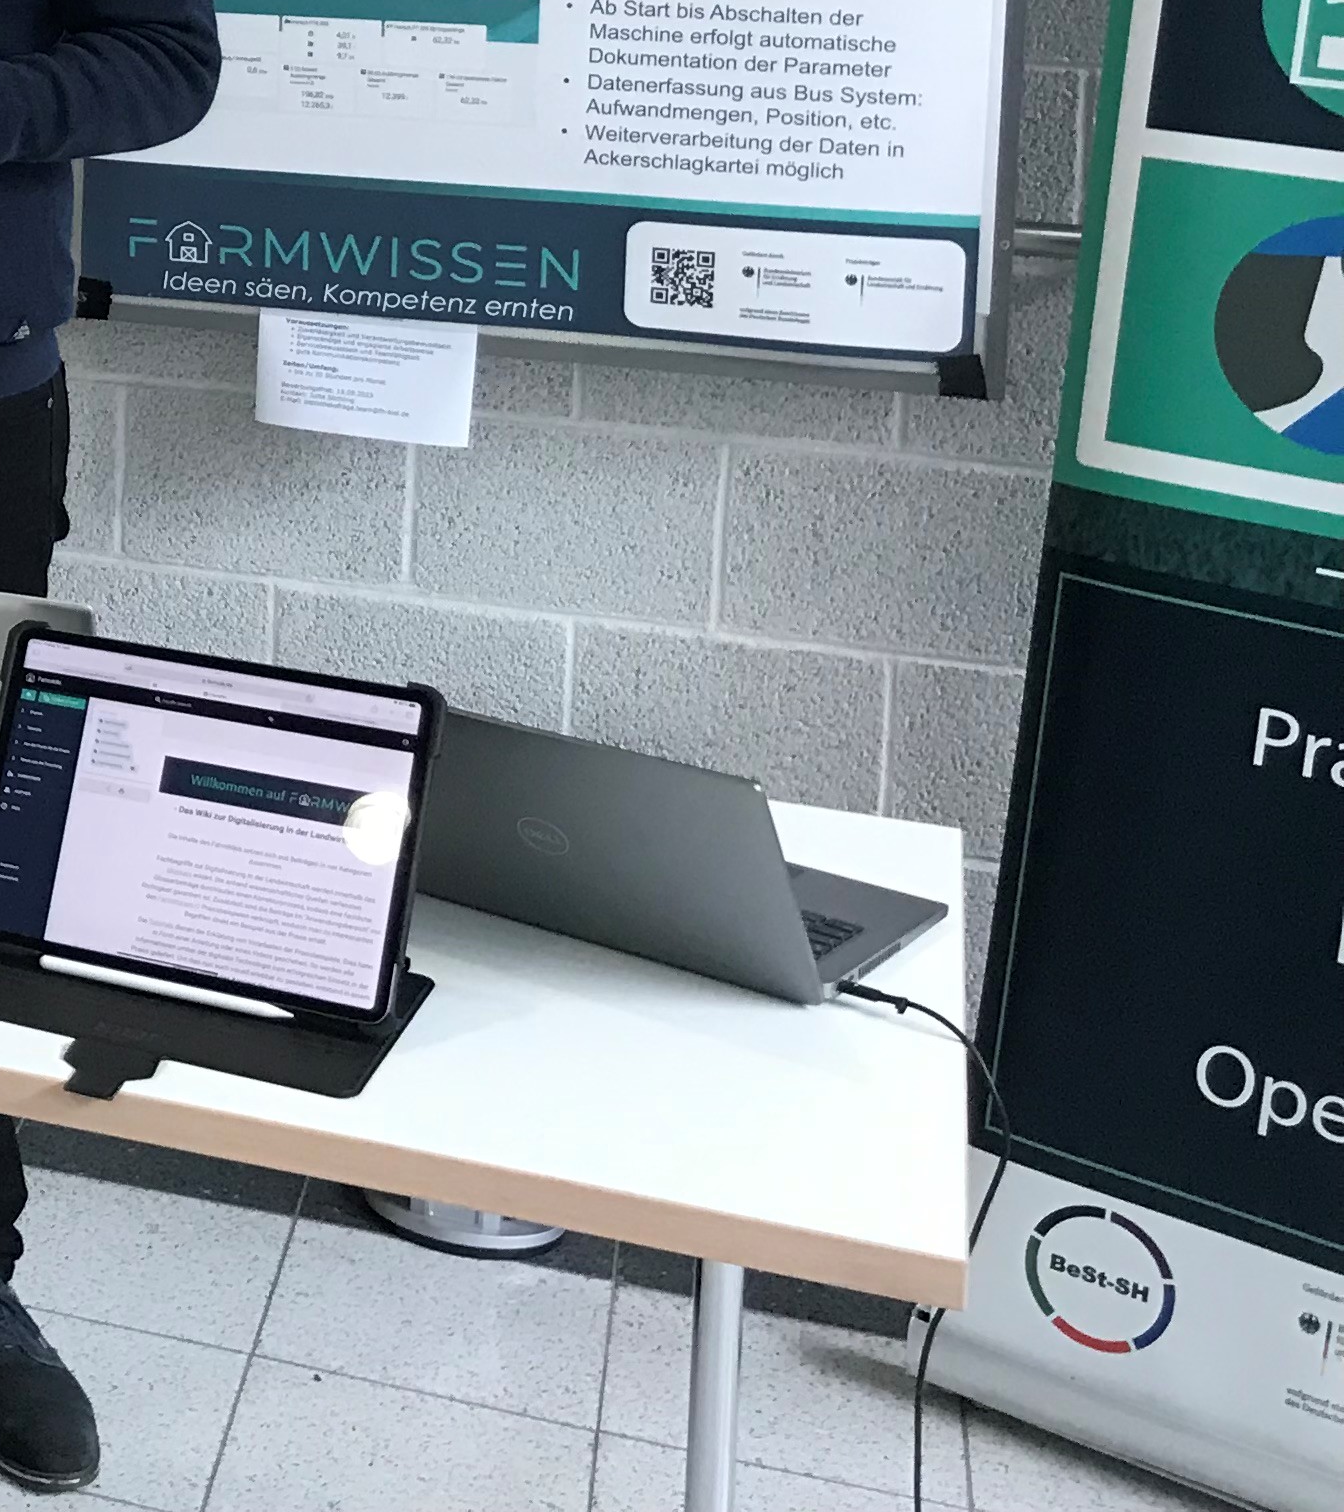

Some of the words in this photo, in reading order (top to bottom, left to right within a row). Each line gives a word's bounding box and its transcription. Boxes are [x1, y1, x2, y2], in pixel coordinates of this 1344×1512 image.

[623, 0, 671, 18] Start
[676, 2, 705, 20] bis
[709, 3, 822, 25] Abschalten
[828, 9, 864, 27] der
[589, 22, 684, 44] Maschine
[690, 28, 753, 51] erfolgt
[759, 33, 897, 53] automatische
[588, 47, 738, 71] Dokumentation
[744, 55, 778, 73] der
[783, 56, 893, 78] Parameter
[587, 73, 744, 103] Datenerfassung
[750, 86, 787, 101] aus
[794, 84, 834, 103] Bus
[840, 86, 923, 108] System:
[585, 98, 758, 130] Aufwandmengen,
[766, 107, 852, 131] Position,
[860, 113, 896, 131] etc.
[584, 124, 773, 155] Weiterverarbeitung
[778, 136, 813, 153] der
[819, 137, 880, 157] Daten
[583, 148, 759, 176] Ackerschlagkartei
[766, 161, 844, 182] möglich
[161, 270, 238, 295] Ideen
[244, 277, 315, 305] säen,
[323, 283, 478, 316] Kompetenz
[485, 298, 575, 323] ernten
[190, 773, 263, 797] Willkommen
[1048, 1253, 1152, 1303] BeSt-SH
